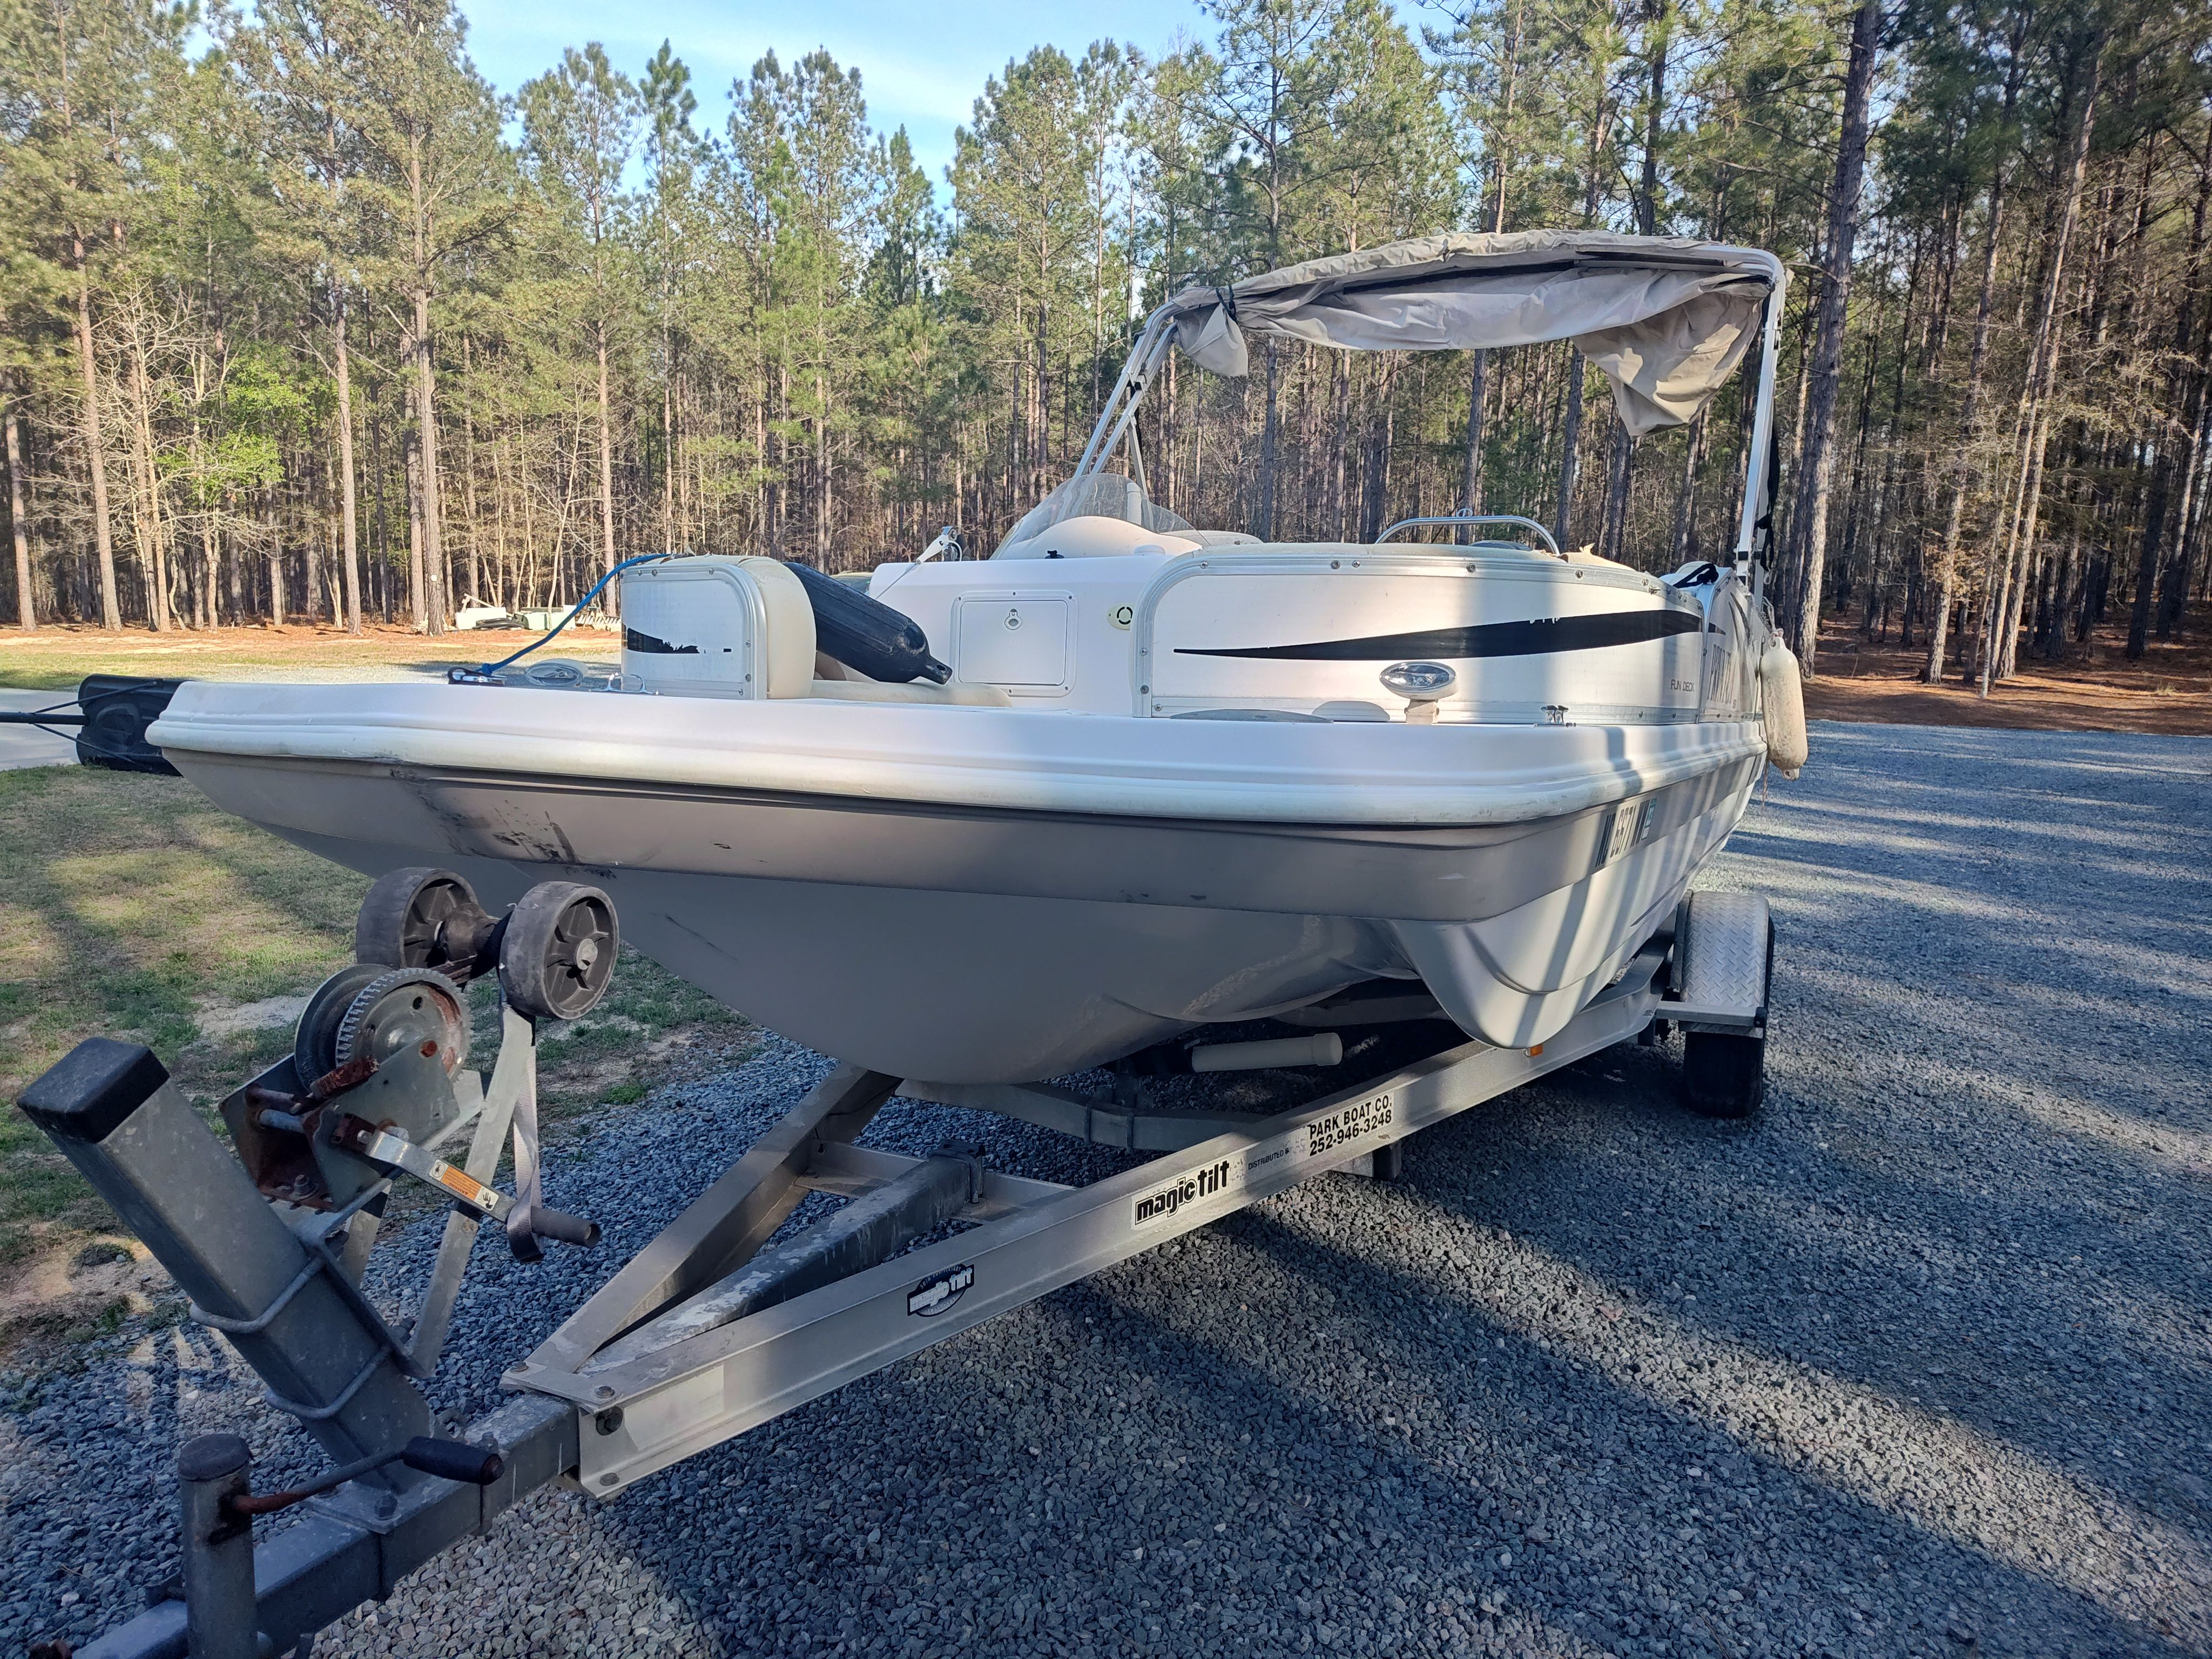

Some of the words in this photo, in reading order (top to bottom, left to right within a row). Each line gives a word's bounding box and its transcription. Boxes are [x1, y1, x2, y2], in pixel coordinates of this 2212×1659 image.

[1670, 679, 1682, 691] FUN
[1682, 681, 1695, 692] DECK
[1595, 813, 1616, 867] NC
[1609, 805, 1637, 858] 6671
[1309, 1115, 1340, 1140] PARK
[1344, 1102, 1372, 1126] BOAT
[1375, 1095, 1392, 1112] CO.
[1310, 1109, 1392, 1157] 252-946-3248
[1248, 1150, 1284, 1170] DISTRIBUTED
